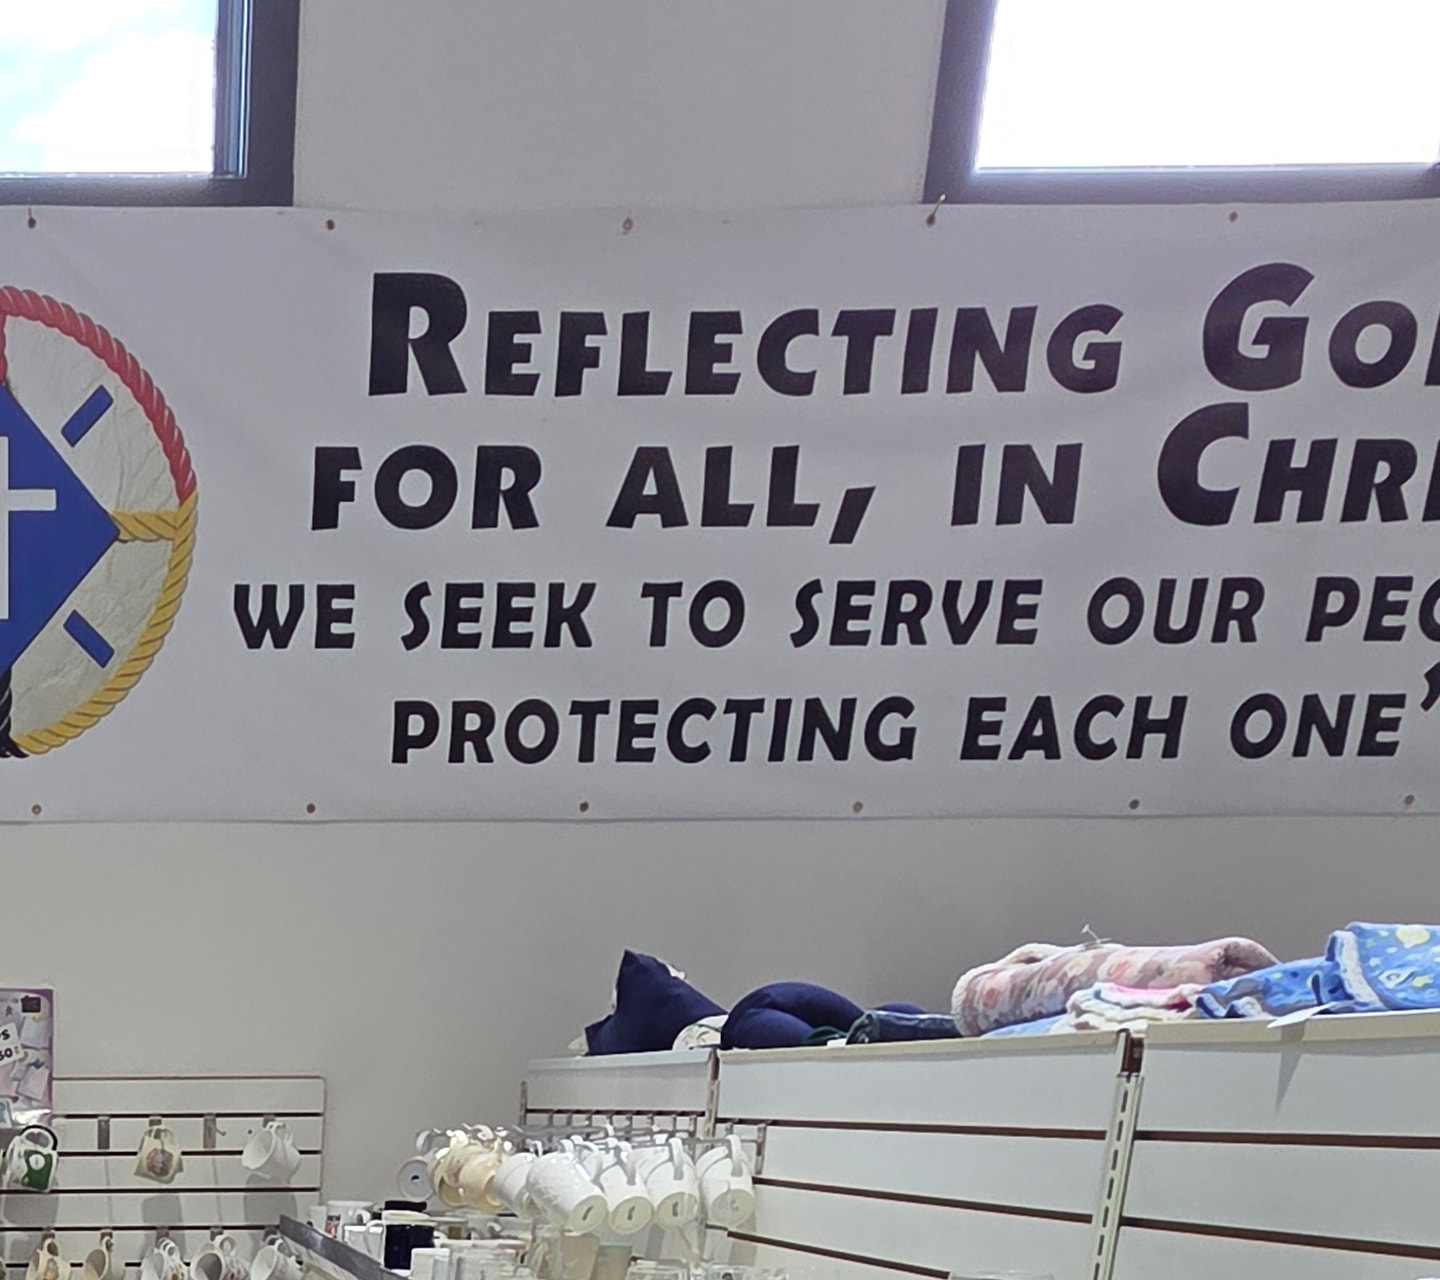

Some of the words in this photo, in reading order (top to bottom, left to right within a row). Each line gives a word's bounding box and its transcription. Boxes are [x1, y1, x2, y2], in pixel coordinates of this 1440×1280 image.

[368, 273, 1124, 398] REFLECTING
[1202, 262, 1440, 392] GO
[312, 445, 542, 531] FOR
[606, 445, 876, 545] ALL,
[950, 442, 1083, 527] IN
[233, 583, 356, 650] WE
[401, 581, 597, 651] SEEK
[640, 579, 745, 649] TO
[789, 578, 1044, 649] SERVE
[1087, 576, 1265, 646] OUR
[391, 697, 917, 765] PROTECTING
[959, 694, 1188, 762] EACH
